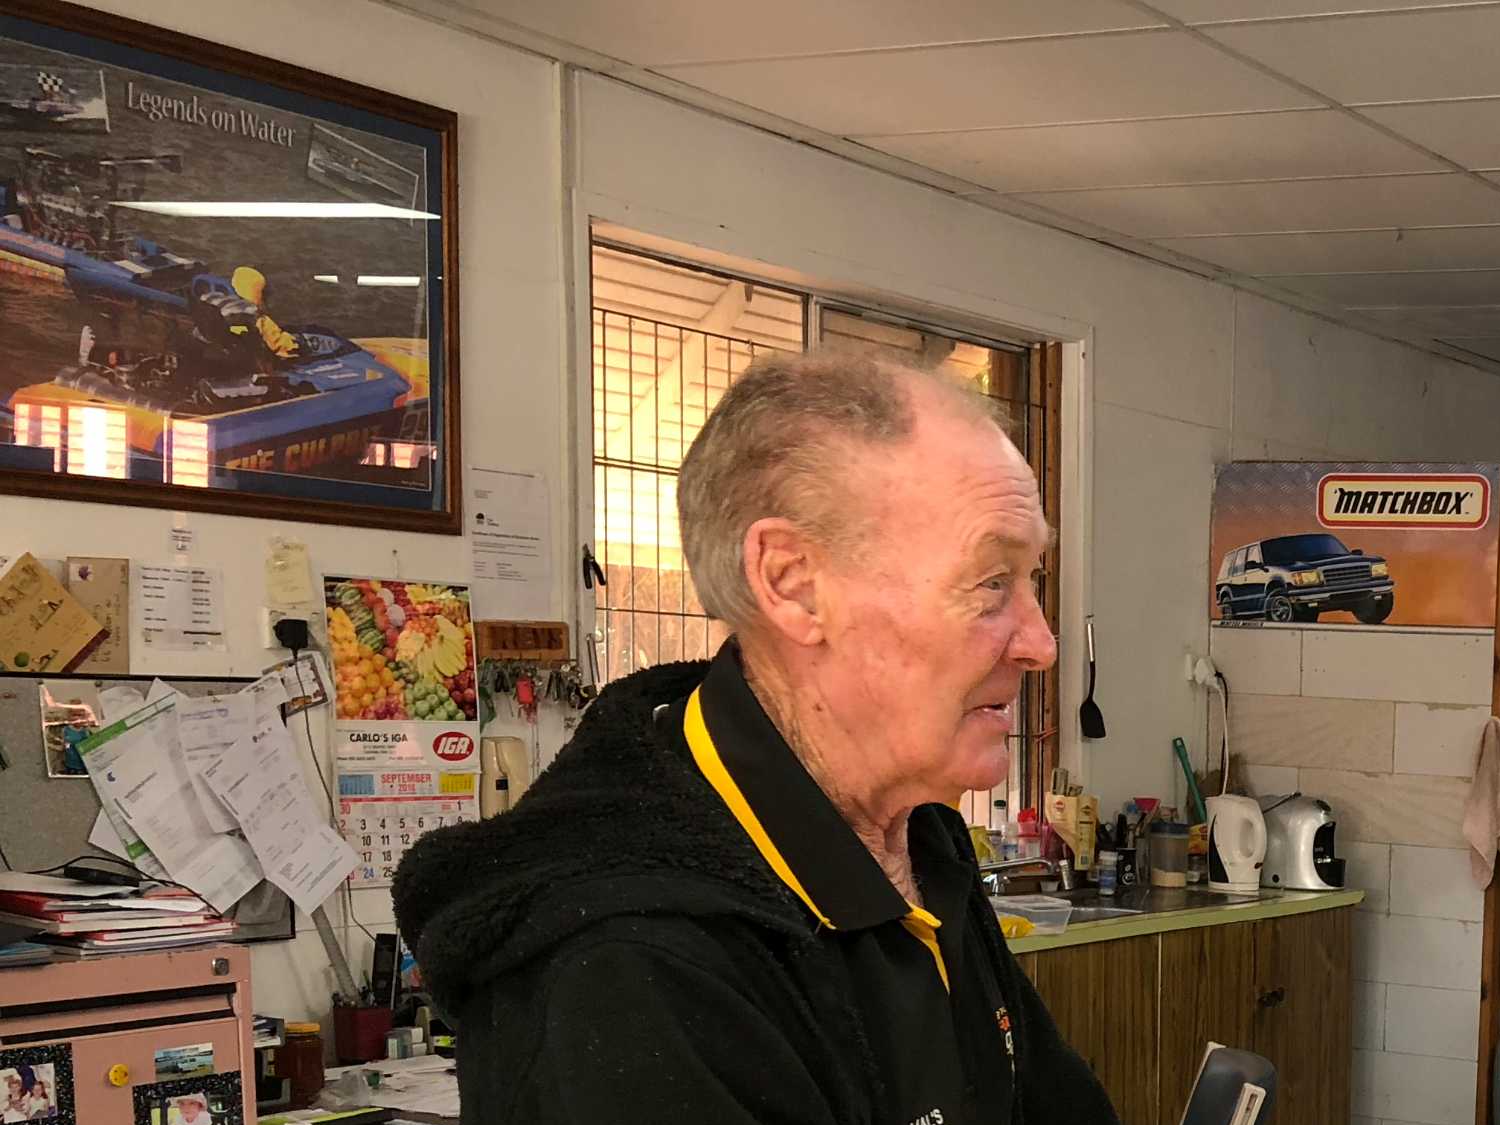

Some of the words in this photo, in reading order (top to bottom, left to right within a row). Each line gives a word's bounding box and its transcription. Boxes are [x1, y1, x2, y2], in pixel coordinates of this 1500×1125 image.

[128, 82, 207, 124] Legends
[211, 109, 236, 133] on
[241, 110, 296, 147] Water
[349, 733, 388, 743] CARLO'S
[391, 733, 408, 743] IGA
[437, 737, 470, 754] IGA
[381, 773, 432, 784] SEPTEMBER
[339, 804, 351, 815] 30
[360, 819, 367, 830] 3
[380, 819, 386, 829] 4
[400, 818, 406, 829] 5
[418, 818, 424, 828] 6
[361, 835, 371, 846] 10
[381, 835, 390, 845] 11
[400, 834, 410, 845] 12
[362, 852, 372, 862] 17
[382, 851, 392, 862] 18
[364, 867, 374, 879] 24
[383, 867, 393, 878] 25
